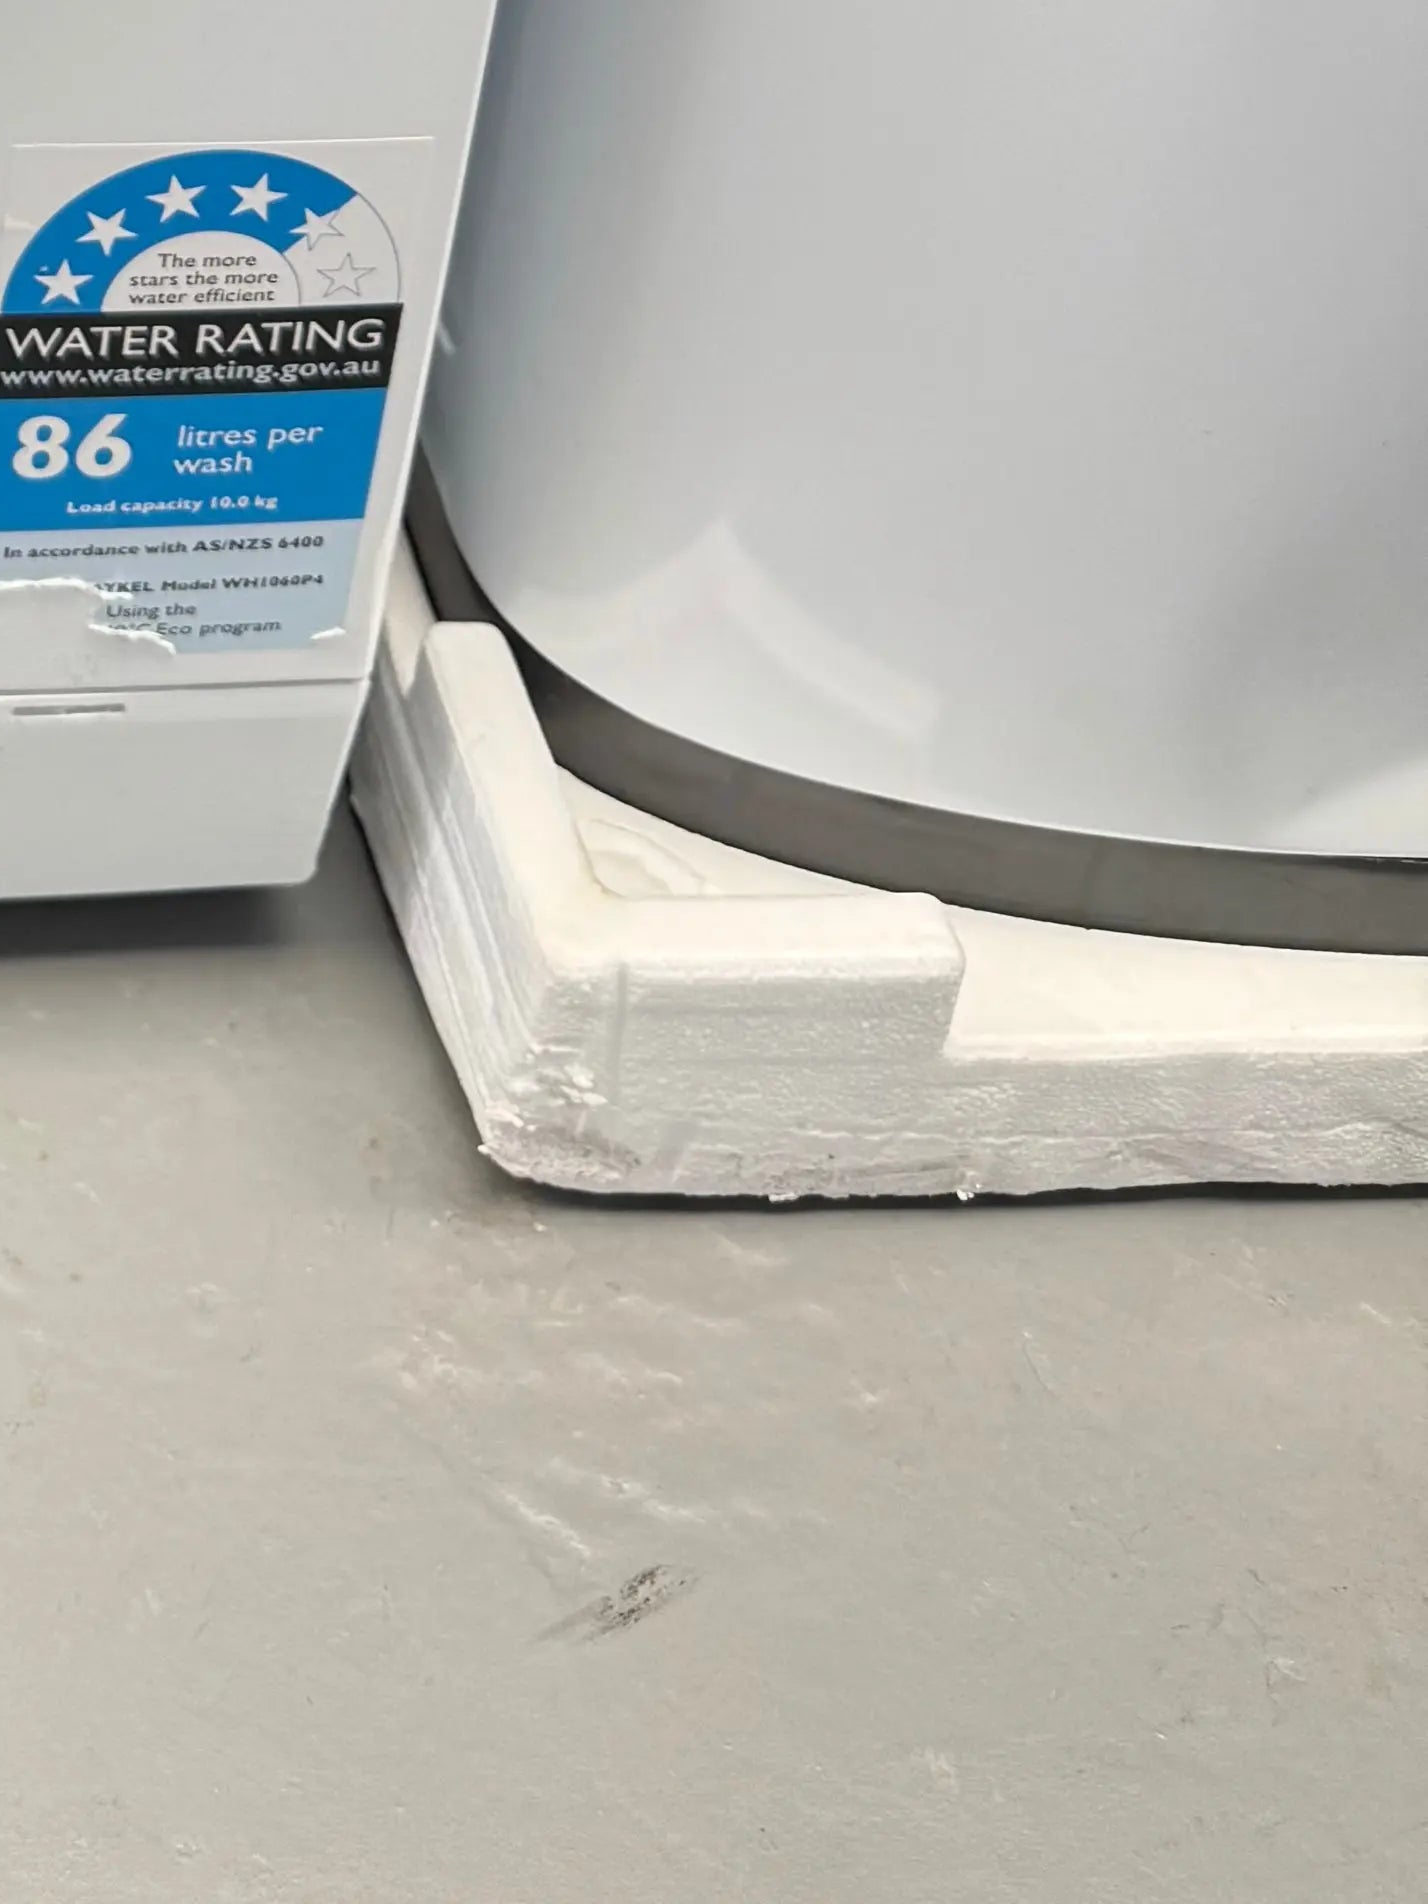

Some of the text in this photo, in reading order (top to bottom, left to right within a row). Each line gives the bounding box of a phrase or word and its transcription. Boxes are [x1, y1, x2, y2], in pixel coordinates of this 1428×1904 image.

[157, 252, 257, 268] The more
[129, 271, 279, 286] stars the more
[128, 287, 276, 304] water efficient
[5, 317, 385, 359] WATER RATING
[0, 357, 381, 387] www.waterrating.gov.au
[11, 412, 133, 480] 86
[177, 425, 324, 452] litres per
[173, 451, 253, 475] wash
[66, 494, 279, 515] Load capacity 10.0 kg
[3, 535, 325, 560] In accordance with AS/NZS 6400
[161, 578, 217, 592] Model
[105, 602, 196, 619] Using the
[156, 622, 193, 636] Eco
[199, 619, 282, 637] program
